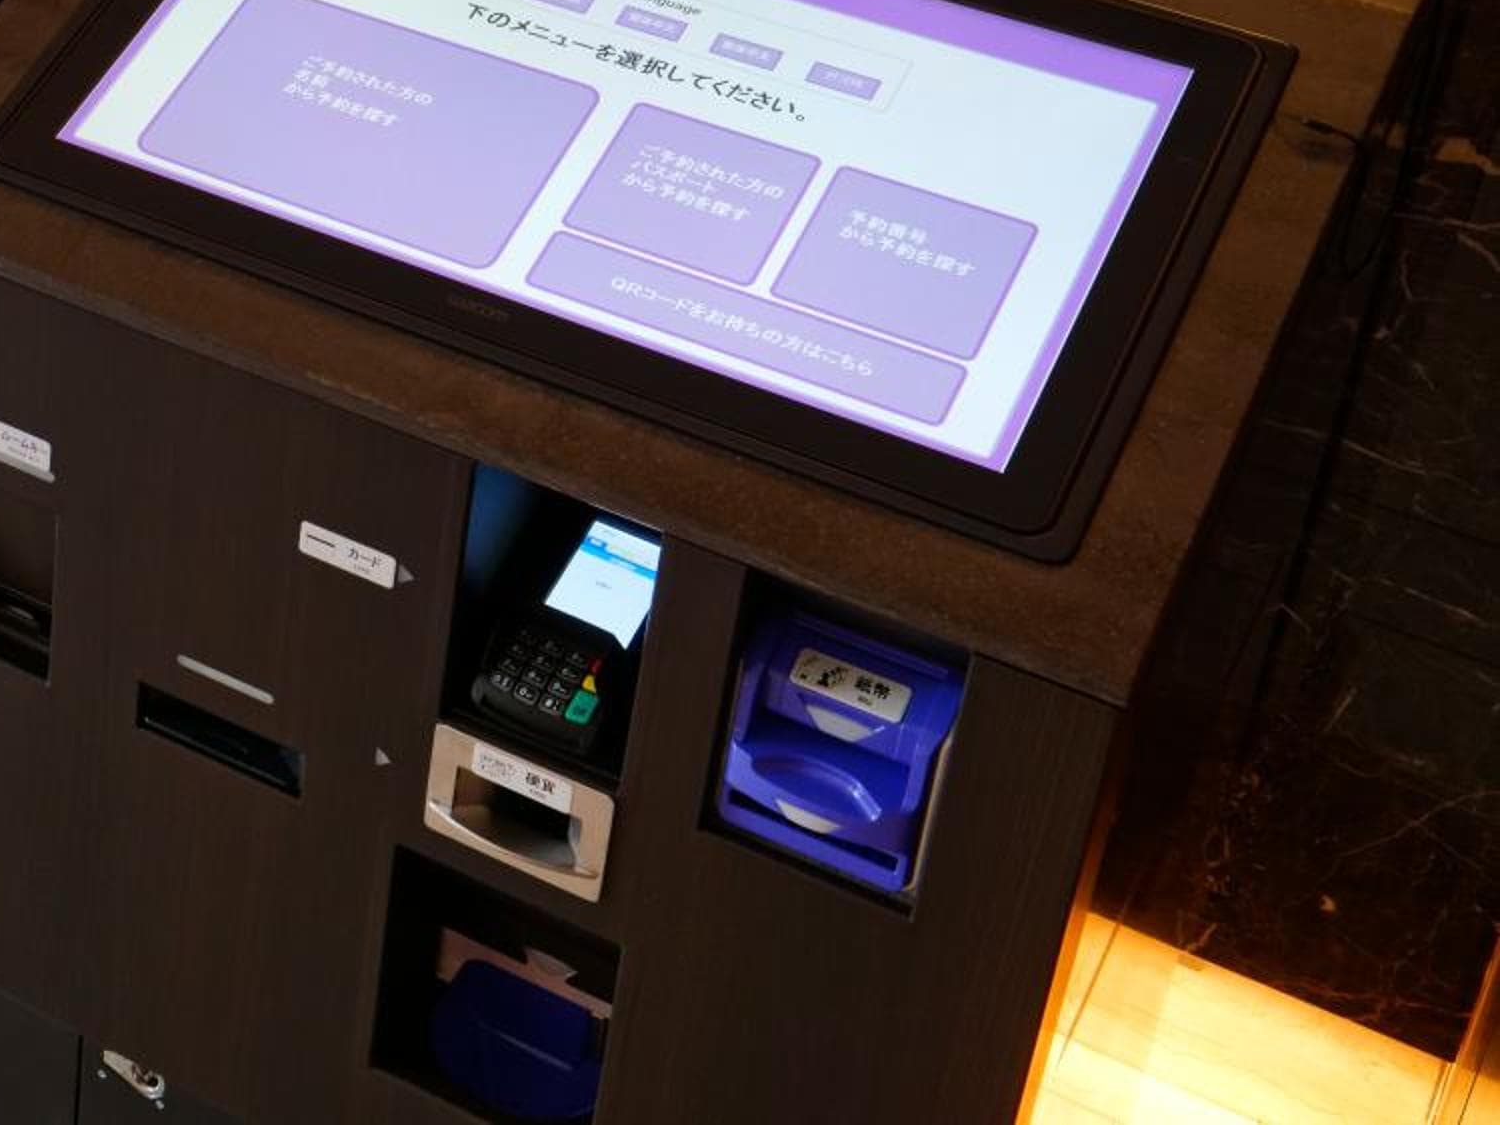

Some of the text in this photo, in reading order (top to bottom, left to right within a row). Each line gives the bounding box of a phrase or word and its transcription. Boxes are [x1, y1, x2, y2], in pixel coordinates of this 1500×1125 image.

[467, 1, 806, 122] 下のメニューを選択してください。
[610, 276, 874, 376] QRコードをお持ちの方はこちら
[347, 547, 383, 568] カード
